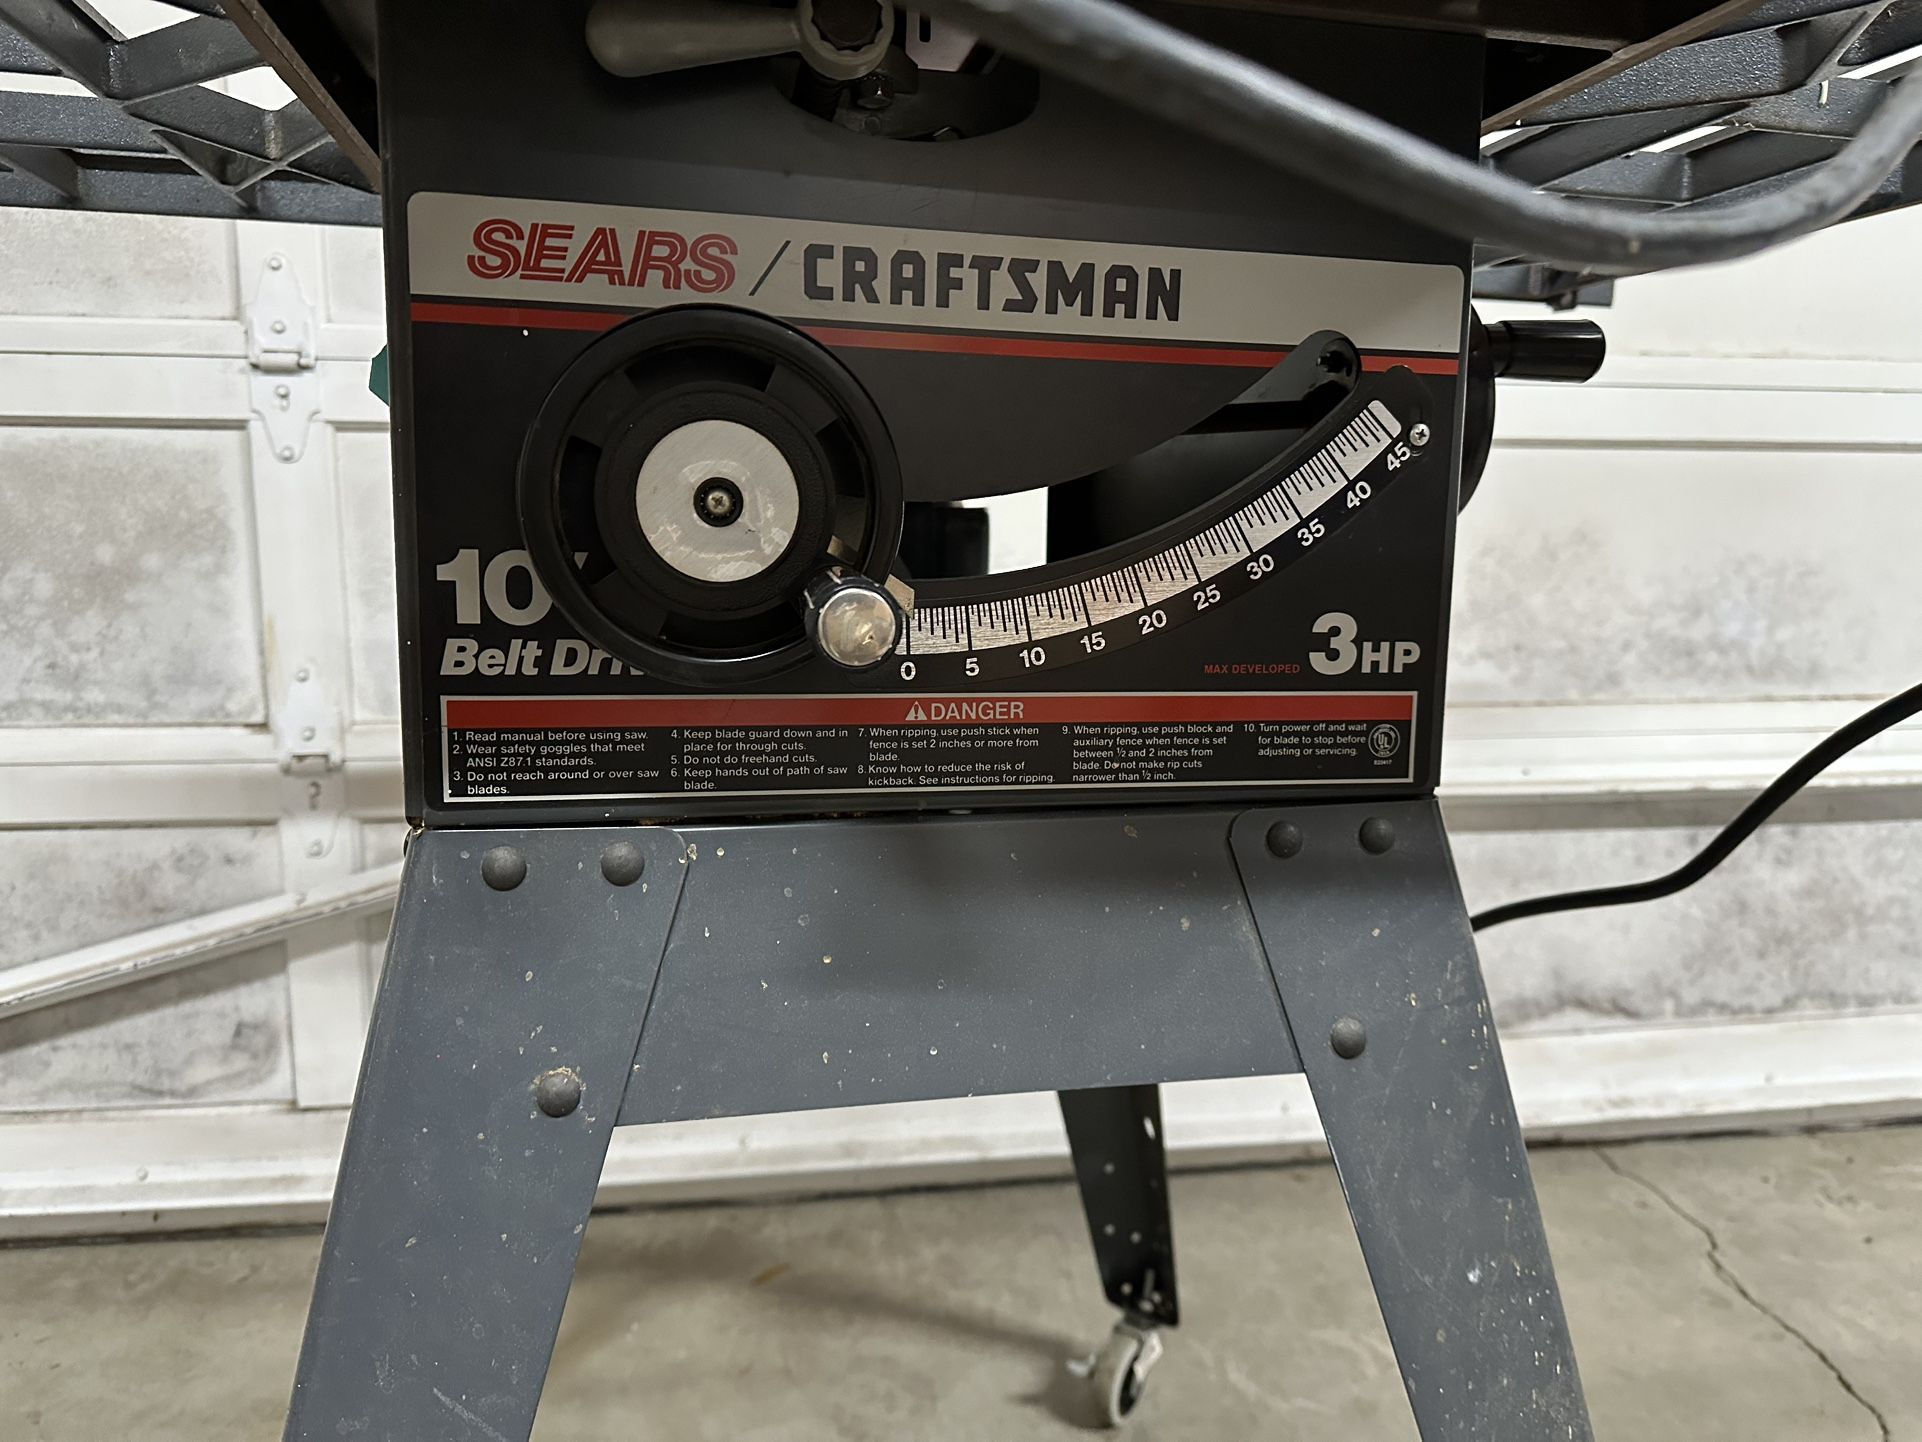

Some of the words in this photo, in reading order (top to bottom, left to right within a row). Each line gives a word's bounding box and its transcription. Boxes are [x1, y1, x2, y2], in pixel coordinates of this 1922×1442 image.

[467, 218, 738, 293] SEARS
[803, 243, 1182, 321] CRAFTSMAN
[901, 662, 915, 680] 0
[966, 658, 979, 676] 5
[1020, 647, 1045, 667] 10
[1081, 632, 1105, 653] 15
[1138, 610, 1167, 635] 20
[1193, 584, 1221, 610] 25
[1247, 553, 1274, 579] 30
[1297, 519, 1325, 547] 35
[1345, 481, 1372, 509] 40
[1386, 444, 1412, 471] 45
[440, 639, 542, 675] Belt
[1204, 665, 1230, 675] MAX
[1231, 664, 1300, 675] DEVELOPED
[931, 701, 1024, 721] DANGER
[858, 727, 866, 736] 7.
[869, 727, 898, 736] When
[900, 728, 938, 737] ripping,
[960, 726, 985, 736] push
[987, 726, 1010, 735] stick
[1012, 726, 1039, 734] when
[1061, 725, 1070, 734] 9.
[1073, 725, 1100, 734] When
[1103, 726, 1139, 735] ripping,
[1161, 724, 1184, 734] push
[1187, 724, 1213, 732] block
[1215, 723, 1233, 732] and
[1243, 723, 1256, 732] 10.
[1258, 723, 1279, 731] Turn
[1281, 725, 1310, 733] power
[1312, 722, 1326, 731] off
[1327, 722, 1345, 731] and
[452, 731, 462, 740] 1.
[465, 732, 496, 741] Read
[500, 731, 544, 740] manual
[547, 731, 586, 740] before
[589, 732, 620, 741] using
[670, 729, 680, 738] 4.
[683, 729, 712, 739] Keep
[715, 729, 745, 738] blade
[748, 728, 780, 739] guard
[783, 728, 812, 737] down
[815, 728, 835, 737] and
[1258, 735, 1271, 744] for
[1273, 735, 1299, 744] blade
[1301, 735, 1311, 743] to
[1313, 735, 1334, 744] stop
[1336, 734, 1367, 743] before
[683, 742, 713, 752] place
[716, 741, 732, 750] for
[735, 741, 778, 752] through
[781, 741, 806, 750] cuts.
[869, 739, 898, 748] fence
[911, 739, 927, 748] set
[929, 738, 936, 747] 2
[938, 738, 971, 747] inches
[1015, 738, 1038, 746] from
[1072, 737, 1114, 747] auxiliary
[1116, 736, 1142, 745] fence
[1144, 736, 1170, 744] when
[1173, 736, 1199, 744] fence
[1212, 736, 1226, 744] set
[452, 745, 462, 754] 2.
[465, 744, 497, 753] Wear
[500, 744, 536, 755] safety
[539, 743, 587, 754] goggles
[590, 742, 612, 751] that
[616, 742, 644, 751] meet
[1072, 749, 1113, 757] between
[1127, 748, 1146, 757] and
[1148, 747, 1154, 756] 2
[1157, 748, 1188, 756] inches
[1190, 747, 1213, 756] from
[1257, 746, 1300, 756] adjusting
[1314, 747, 1357, 756] servicing.
[466, 758, 496, 767] ANSI
[500, 757, 530, 766] Z87.1
[535, 756, 596, 766] standards.
[670, 755, 680, 764] 5.
[683, 755, 699, 764] Do
[702, 755, 720, 763] not
[723, 754, 738, 763] do
[741, 754, 789, 763] freehand
[792, 753, 817, 762] cuts.
[869, 752, 899, 761] blade.
[857, 764, 866, 773] 8.
[868, 764, 897, 773] Know
[900, 764, 921, 772] how
[924, 764, 934, 772] to
[937, 763, 972, 772] reduce
[975, 762, 991, 771] the
[993, 761, 1011, 770] risk
[1014, 761, 1024, 770] of
[1072, 760, 1101, 769] blade.
[1120, 760, 1136, 768] not
[1138, 760, 1164, 768] make
[1167, 761, 1180, 769] rip
[1182, 759, 1202, 767] cuts
[453, 771, 463, 780] 3.
[467, 772, 484, 781] Do
[487, 771, 507, 780] not
[511, 771, 544, 780] reach
[547, 770, 589, 779] around
[670, 768, 680, 777] 6.
[684, 767, 712, 778] Keep
[715, 767, 748, 776] hands
[751, 766, 769, 775] out
[772, 766, 783, 775] of
[786, 765, 810, 776] path
[813, 765, 824, 774] of
[1118, 772, 1139, 780] than
[1153, 771, 1175, 780] inch.
[683, 780, 716, 789] blade.
[868, 776, 916, 785] kickback.
[918, 775, 938, 784] See
[941, 774, 1000, 783] instructions
[1002, 773, 1016, 782] for
[1018, 774, 1055, 783] ripping.
[467, 785, 509, 794] blades.
